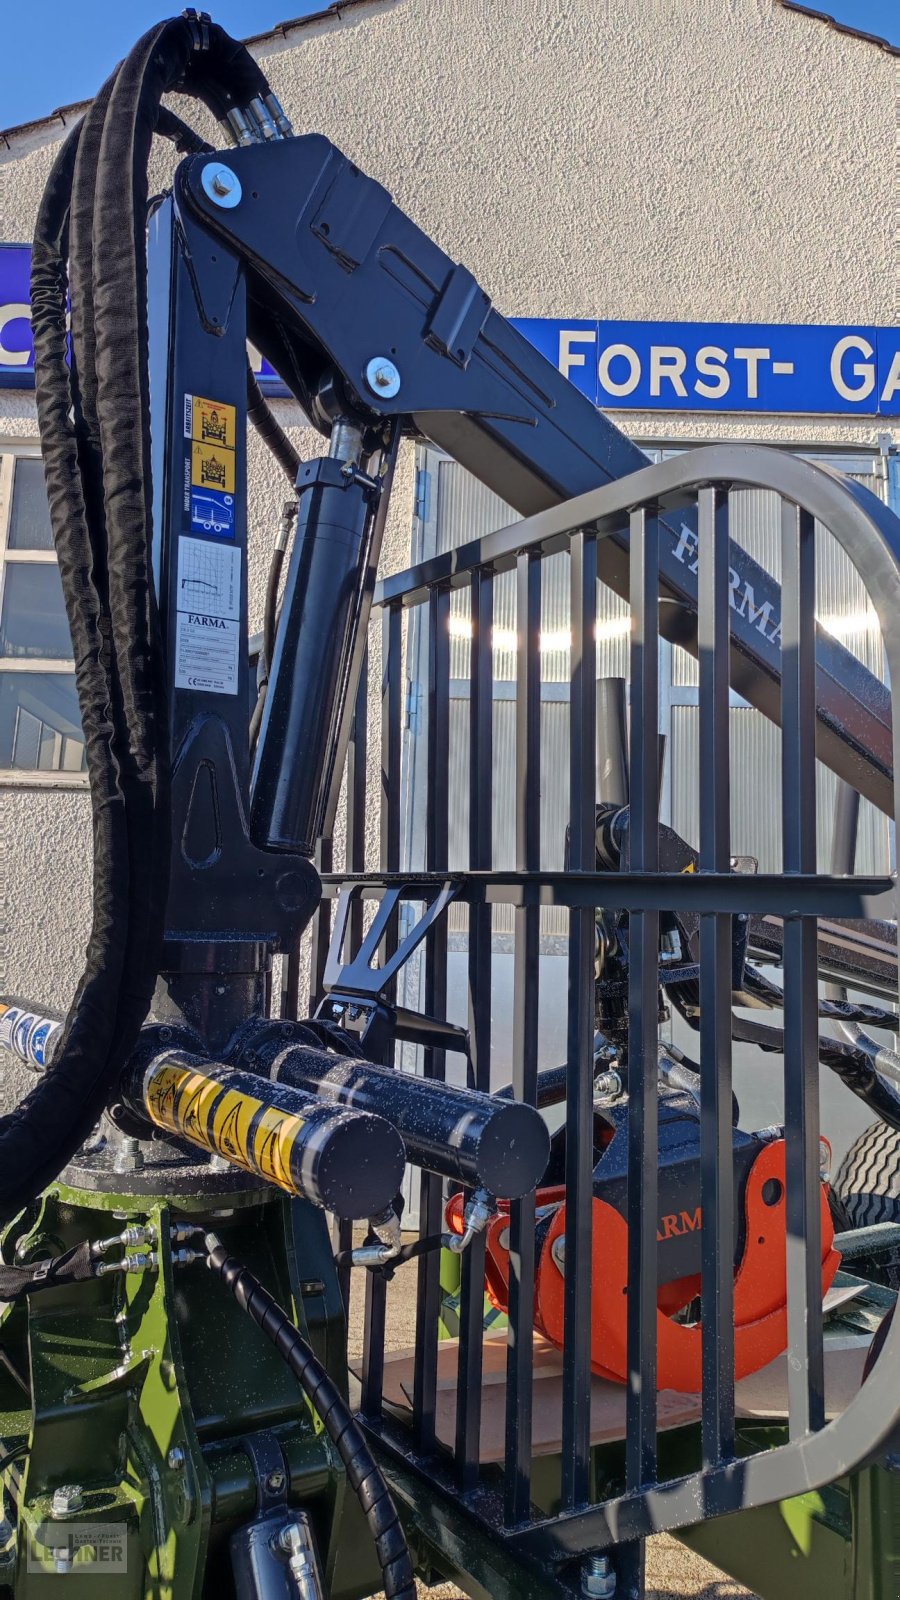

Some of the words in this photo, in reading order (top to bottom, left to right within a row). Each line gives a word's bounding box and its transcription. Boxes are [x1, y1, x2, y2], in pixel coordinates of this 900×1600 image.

[558, 330, 794, 399] FORST-
[672, 523, 782, 650] FRM
[188, 614, 226, 629] FARMA
